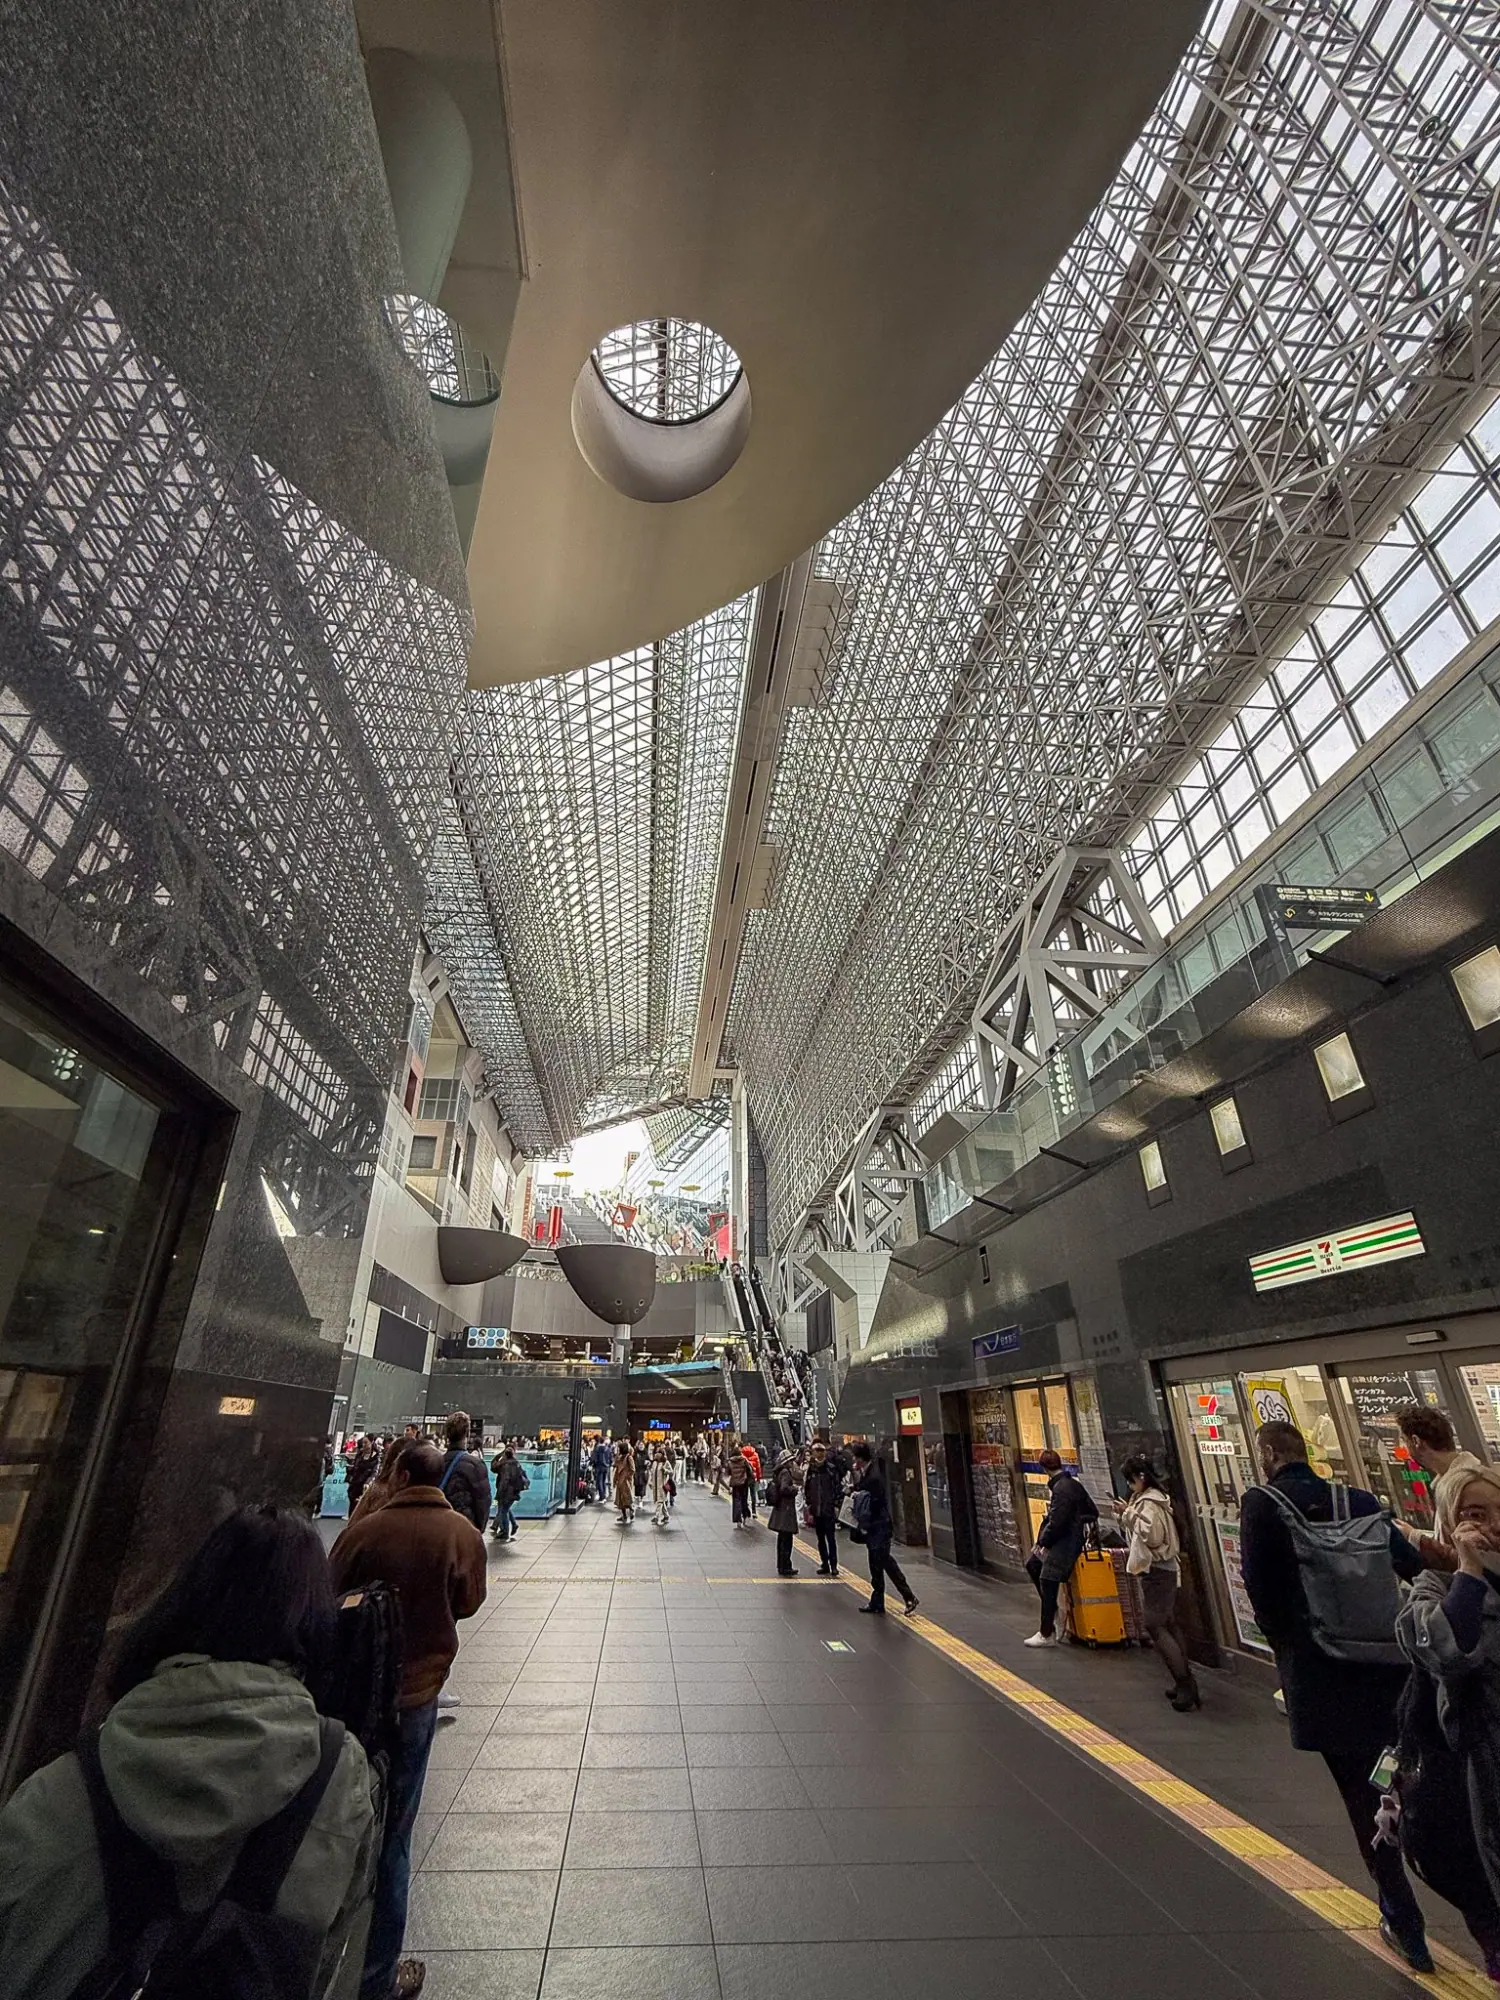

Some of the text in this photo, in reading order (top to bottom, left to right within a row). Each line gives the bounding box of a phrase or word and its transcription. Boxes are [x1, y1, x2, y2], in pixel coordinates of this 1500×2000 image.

[1317, 1241, 1331, 1265] 7
[1355, 1395, 1418, 1404] ブルーマウンテン
[1358, 1405, 1389, 1413] ブレンド
[1201, 1443, 1233, 1453] Heart-in
